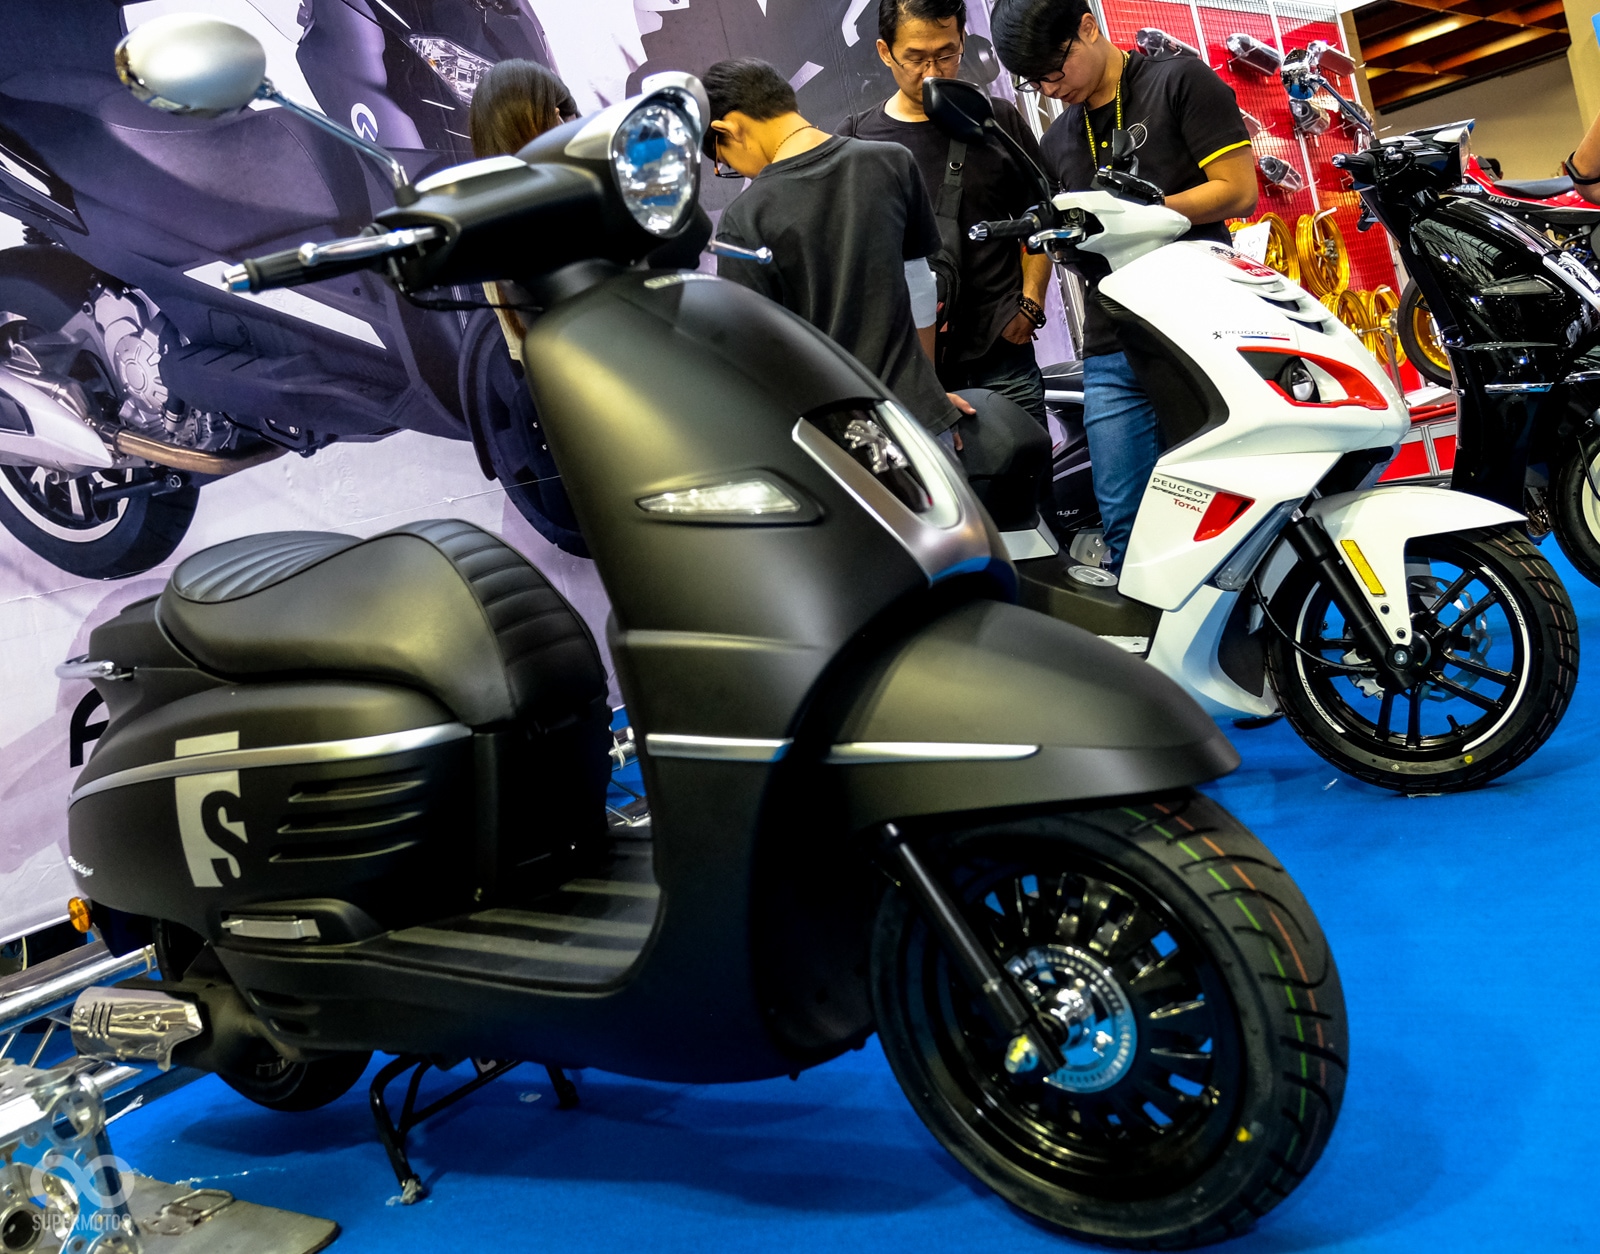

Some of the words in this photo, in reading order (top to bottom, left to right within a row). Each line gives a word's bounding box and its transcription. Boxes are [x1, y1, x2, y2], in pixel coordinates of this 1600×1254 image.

[1488, 195, 1519, 207] DENSO
[1150, 485, 1208, 505] SPEEDFIGHT
[1152, 477, 1211, 499] PEUGEOT
[1173, 498, 1203, 513] TOTAL
